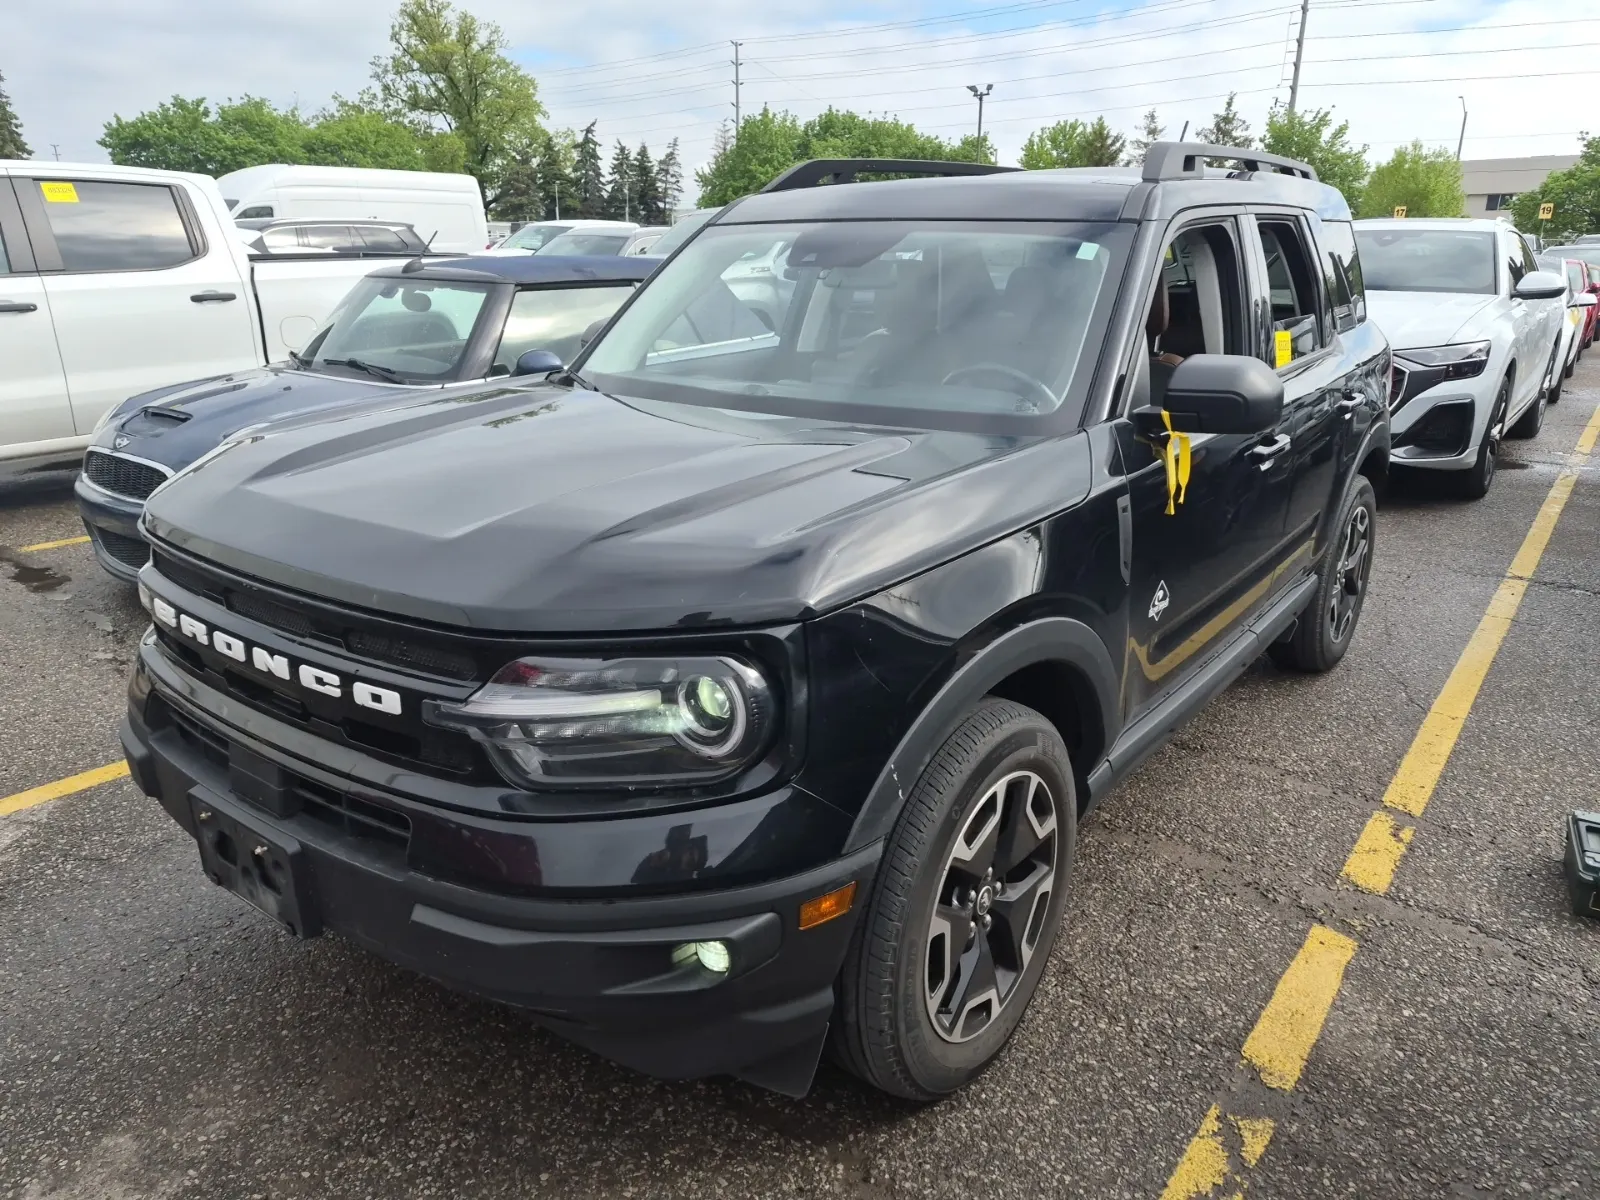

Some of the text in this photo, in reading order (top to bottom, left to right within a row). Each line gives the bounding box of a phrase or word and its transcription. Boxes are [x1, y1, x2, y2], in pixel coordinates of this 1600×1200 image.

[1395, 208, 1406, 217] 17
[1541, 206, 1552, 215] 19
[153, 597, 402, 715] BRONCO
